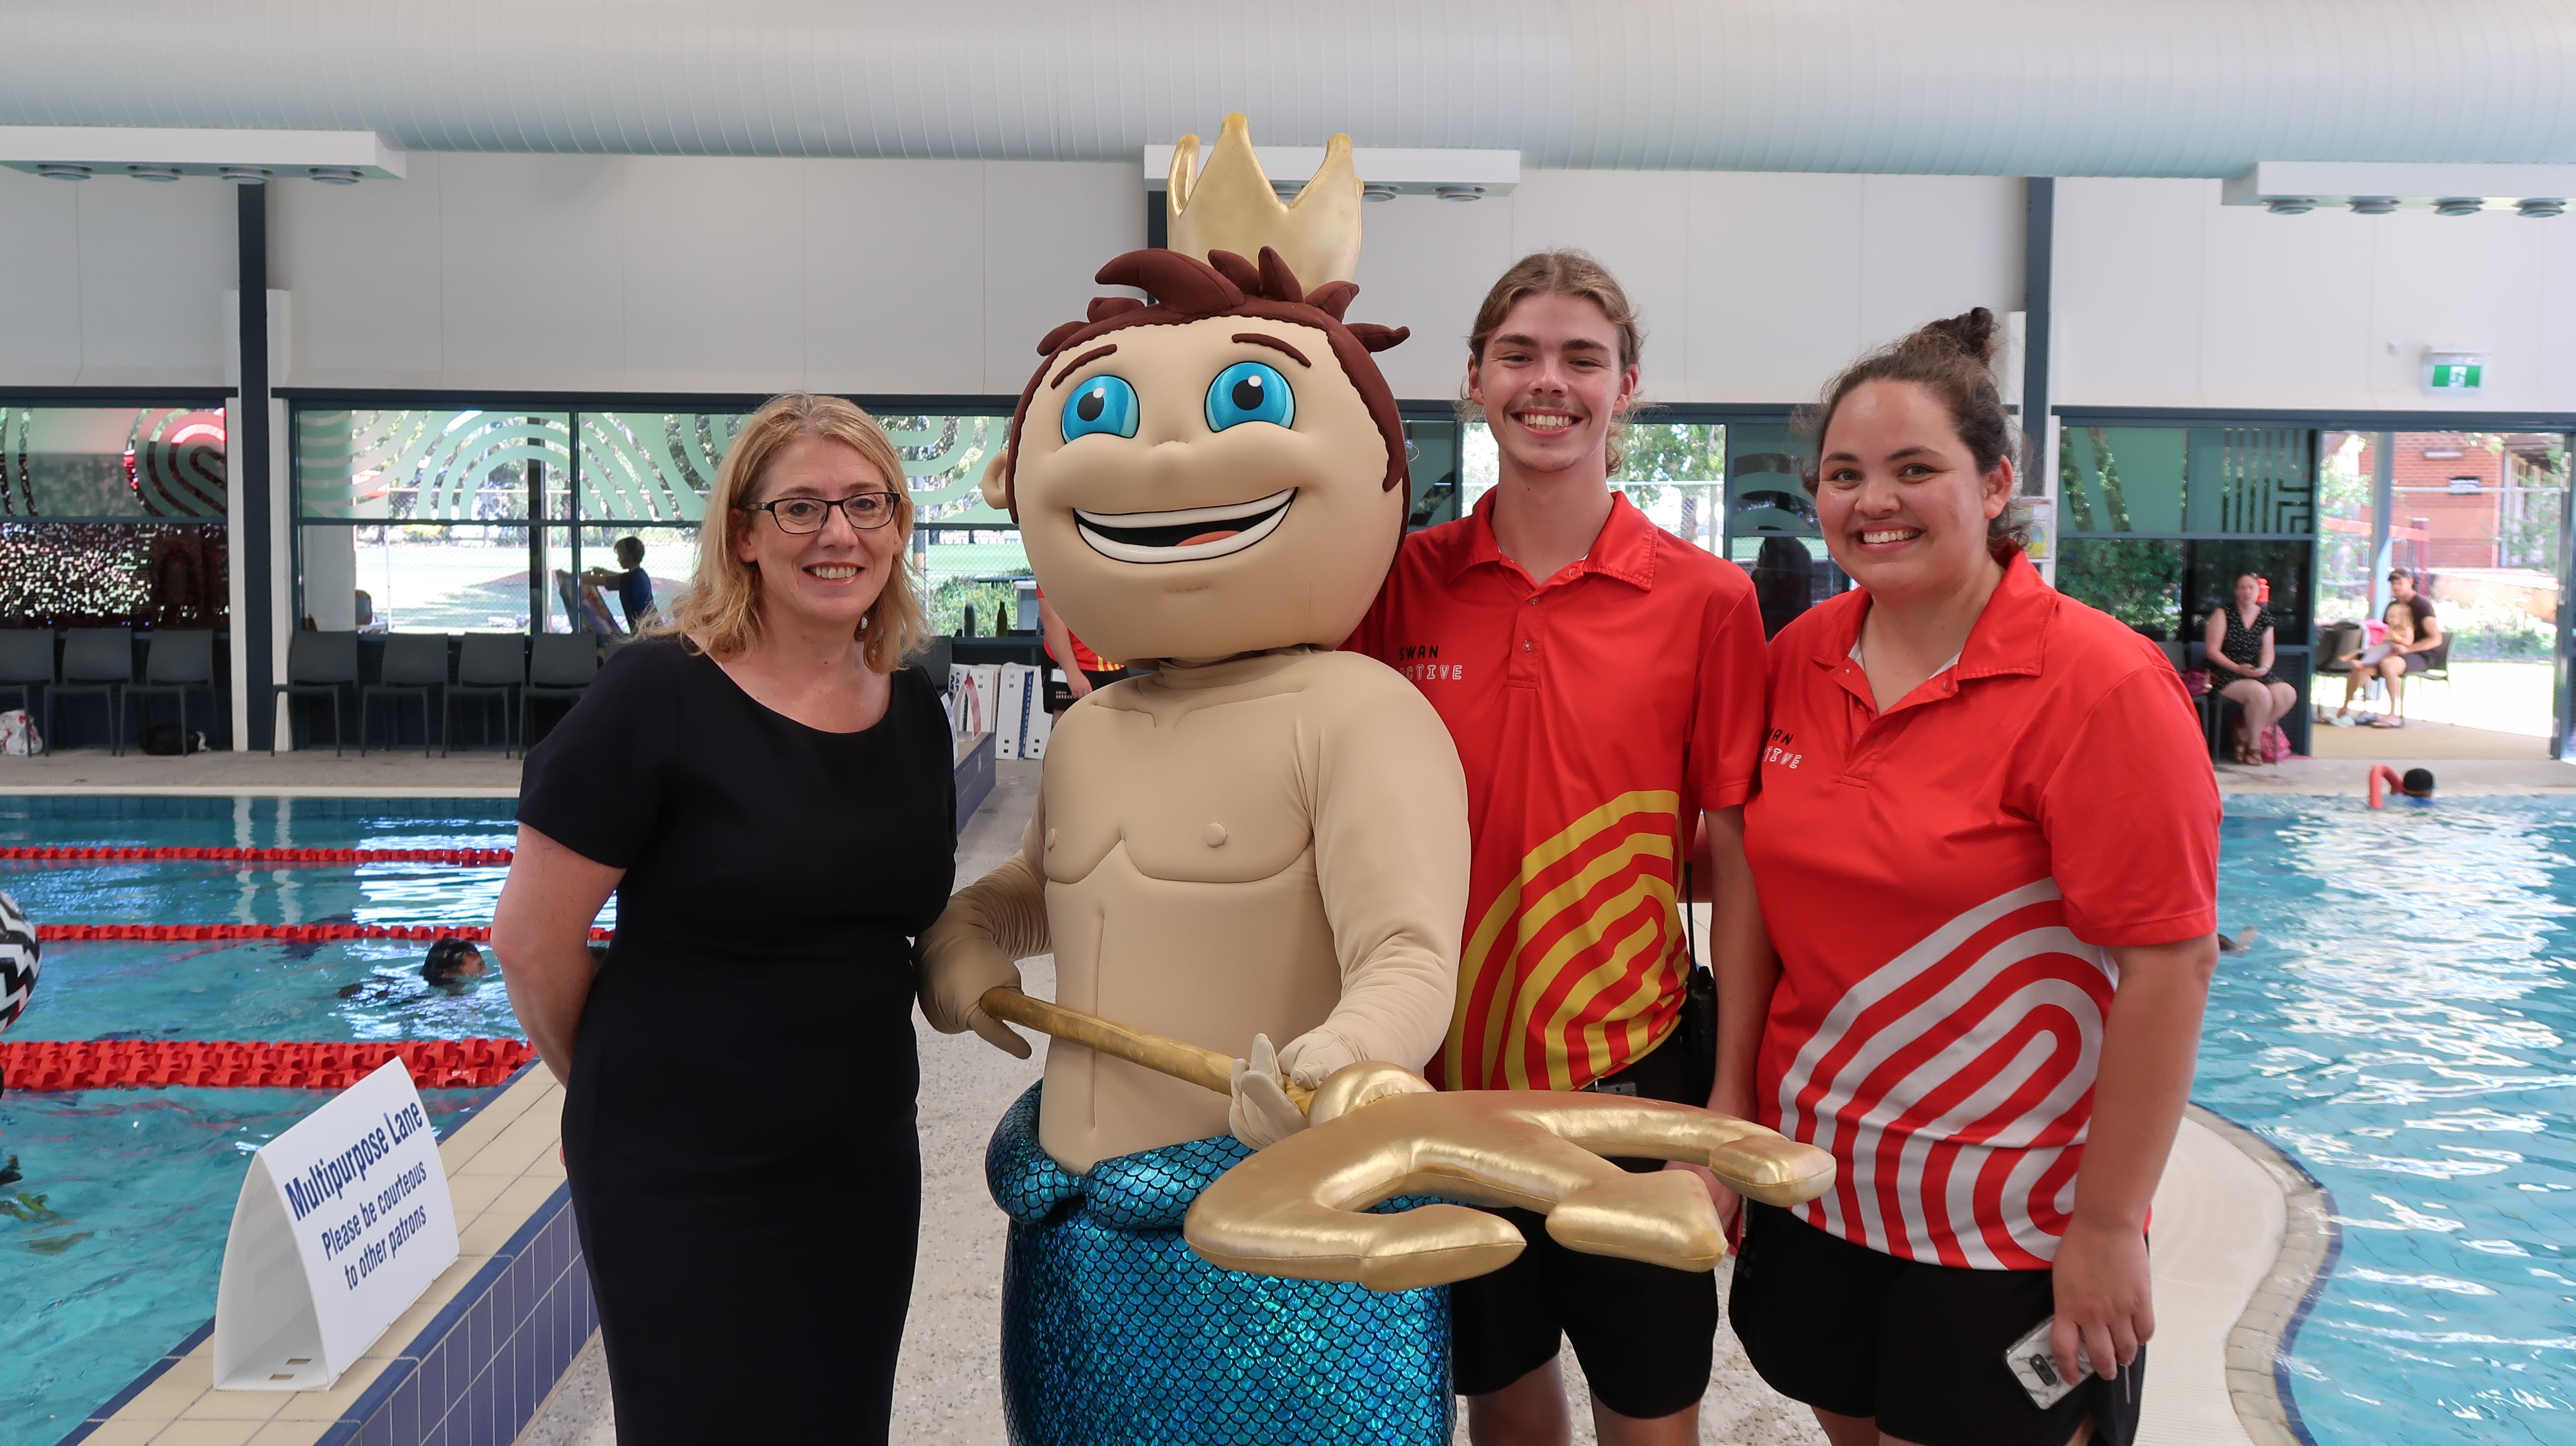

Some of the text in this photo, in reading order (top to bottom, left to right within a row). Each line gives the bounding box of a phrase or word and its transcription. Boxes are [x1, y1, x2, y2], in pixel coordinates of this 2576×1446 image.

[1399, 645, 1439, 661] SWAN
[285, 1102, 423, 1221] Multipurpose Lane
[322, 1161, 427, 1261] Please be courteous
[345, 1205, 427, 1291] to other patrons
